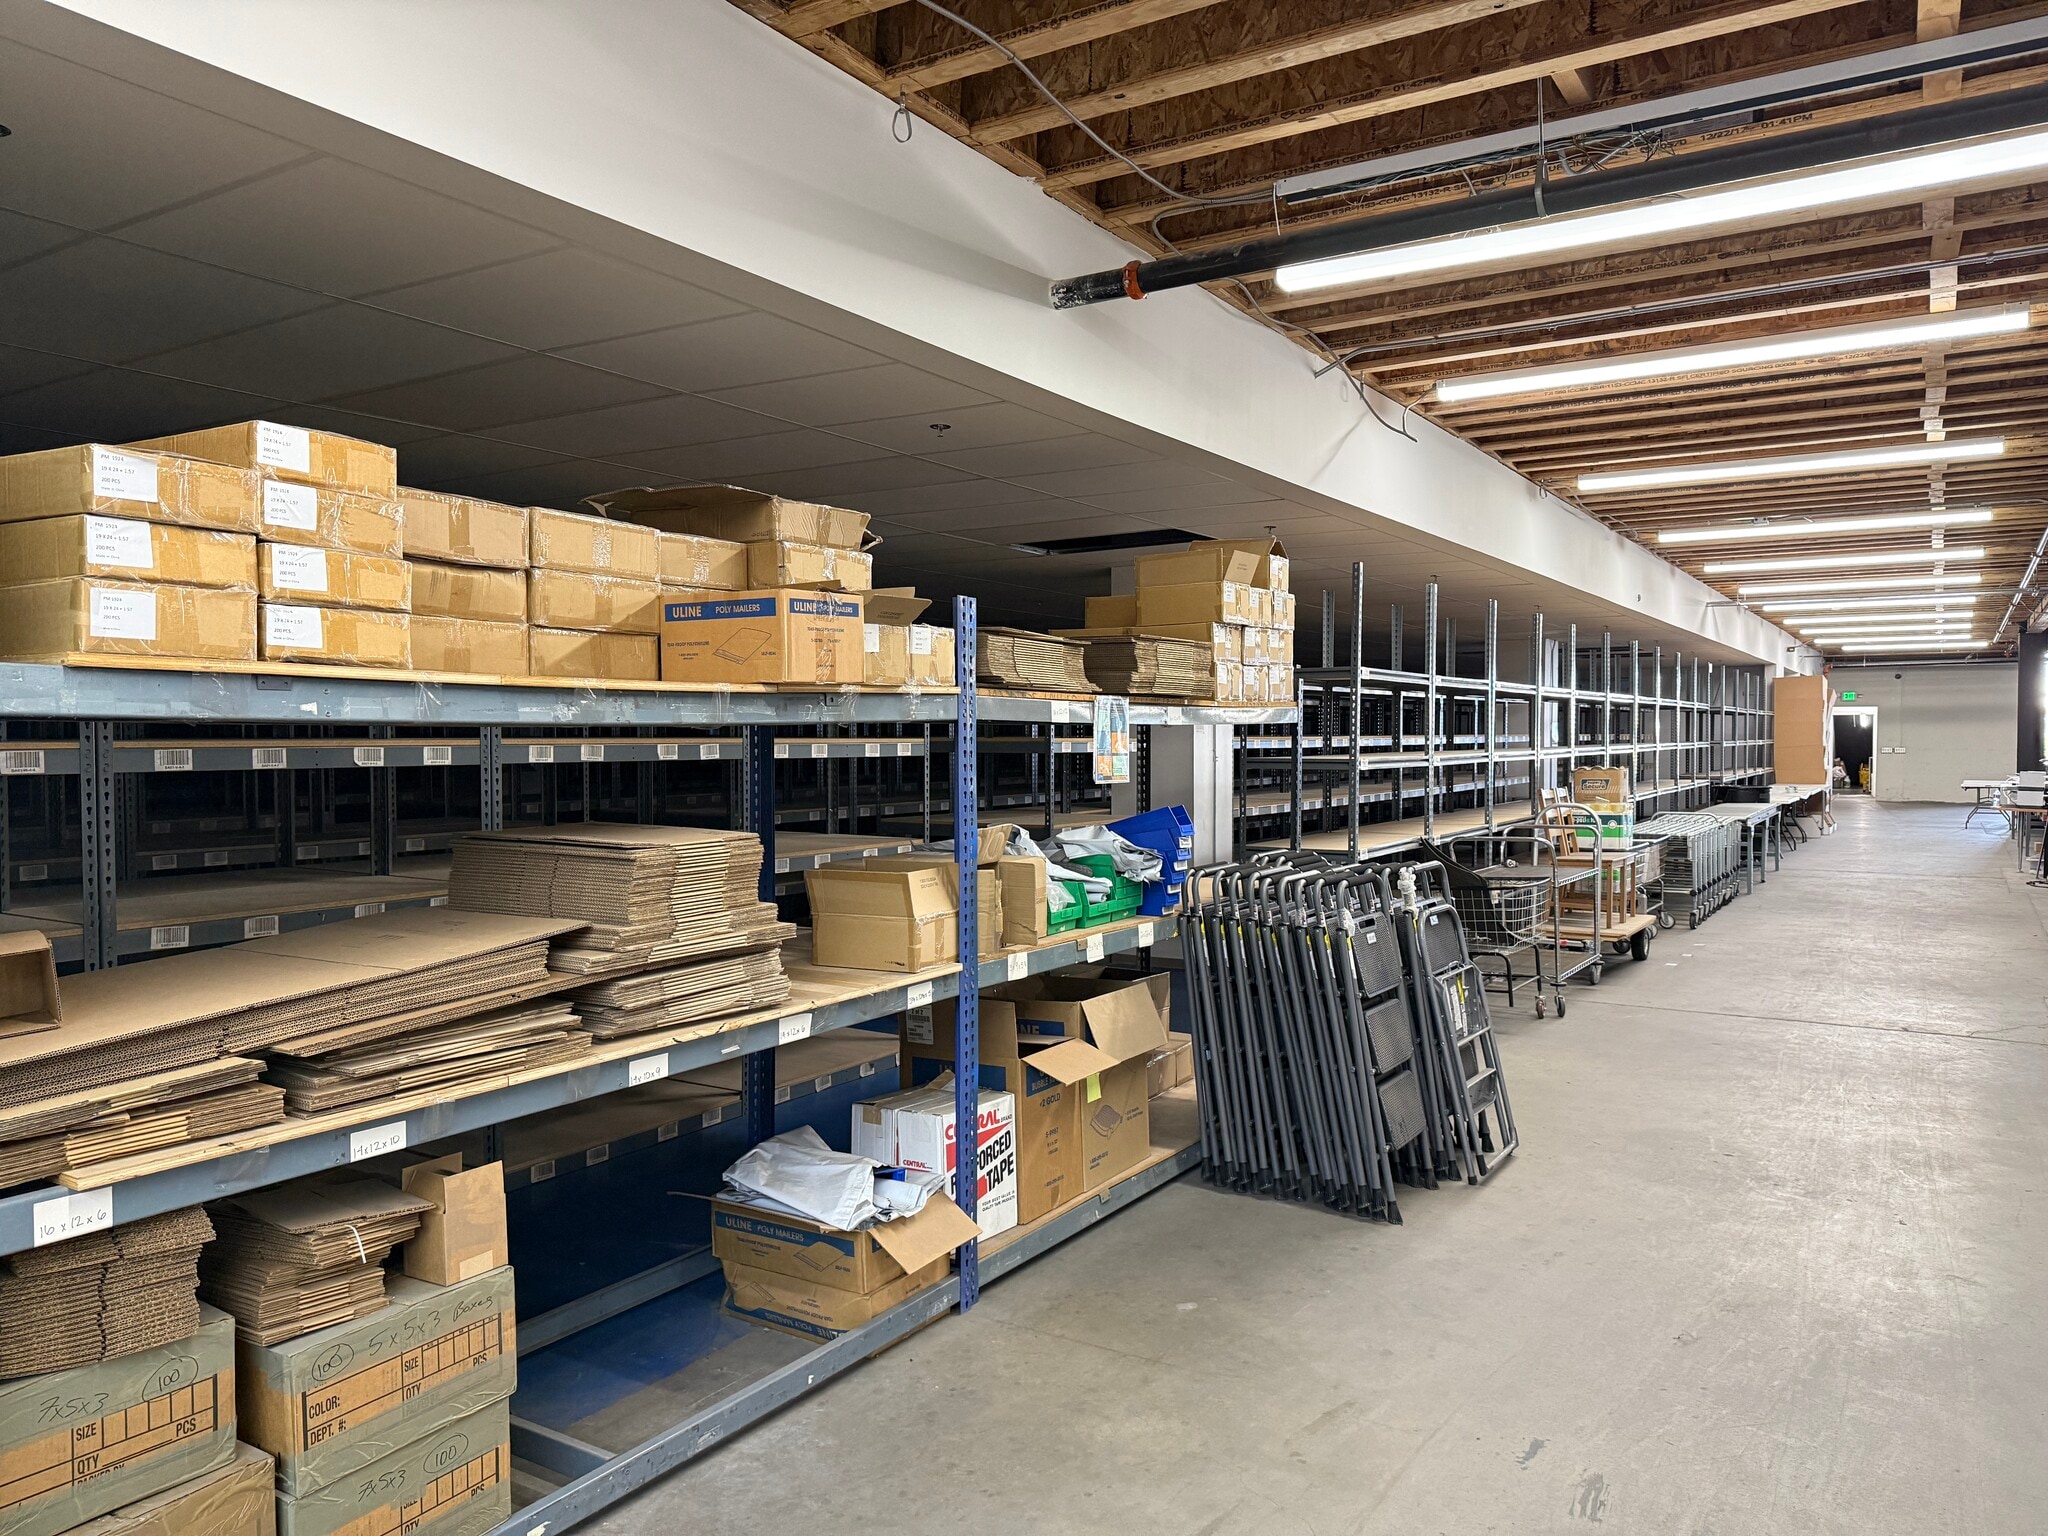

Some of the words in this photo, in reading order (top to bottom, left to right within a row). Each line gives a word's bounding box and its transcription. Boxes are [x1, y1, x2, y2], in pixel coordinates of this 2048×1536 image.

[1126, 138, 1179, 158] CERTIFIED
[1181, 124, 1238, 143] SOURCING
[1299, 103, 1326, 115] 0570
[1761, 112, 1813, 130] 01:41PM
[1401, 131, 1463, 151] SOURCING
[1624, 261, 1678, 275] SOURCING
[672, 605, 702, 618] ULINE
[715, 606, 732, 615] POLY
[733, 603, 761, 613] MAILERS
[793, 601, 817, 612] ULINE
[1032, 1078, 1049, 1092] BUBBLE
[1047, 1093, 1061, 1106] GOLD
[903, 1159, 928, 1170] CENTRAL
[986, 1151, 1015, 1193] TAPE
[40, 1224, 55, 1239] 16
[71, 1215, 84, 1229] 12
[96, 1208, 107, 1221] 6
[725, 1216, 752, 1231] ULINE
[757, 1224, 774, 1236] POLY
[775, 1228, 804, 1242] MAILERS
[404, 1356, 419, 1373] SIZE
[472, 1352, 488, 1368] PCS
[158, 1368, 181, 1393] 100
[309, 1395, 341, 1420] COLOR:
[405, 1382, 422, 1400] QTY
[75, 1422, 98, 1442] SIZE
[176, 1416, 197, 1438] PCS
[310, 1423, 334, 1446] DEPT.
[338, 1418, 347, 1433] #:
[76, 1453, 99, 1476] QTY
[435, 1445, 457, 1468] 100
